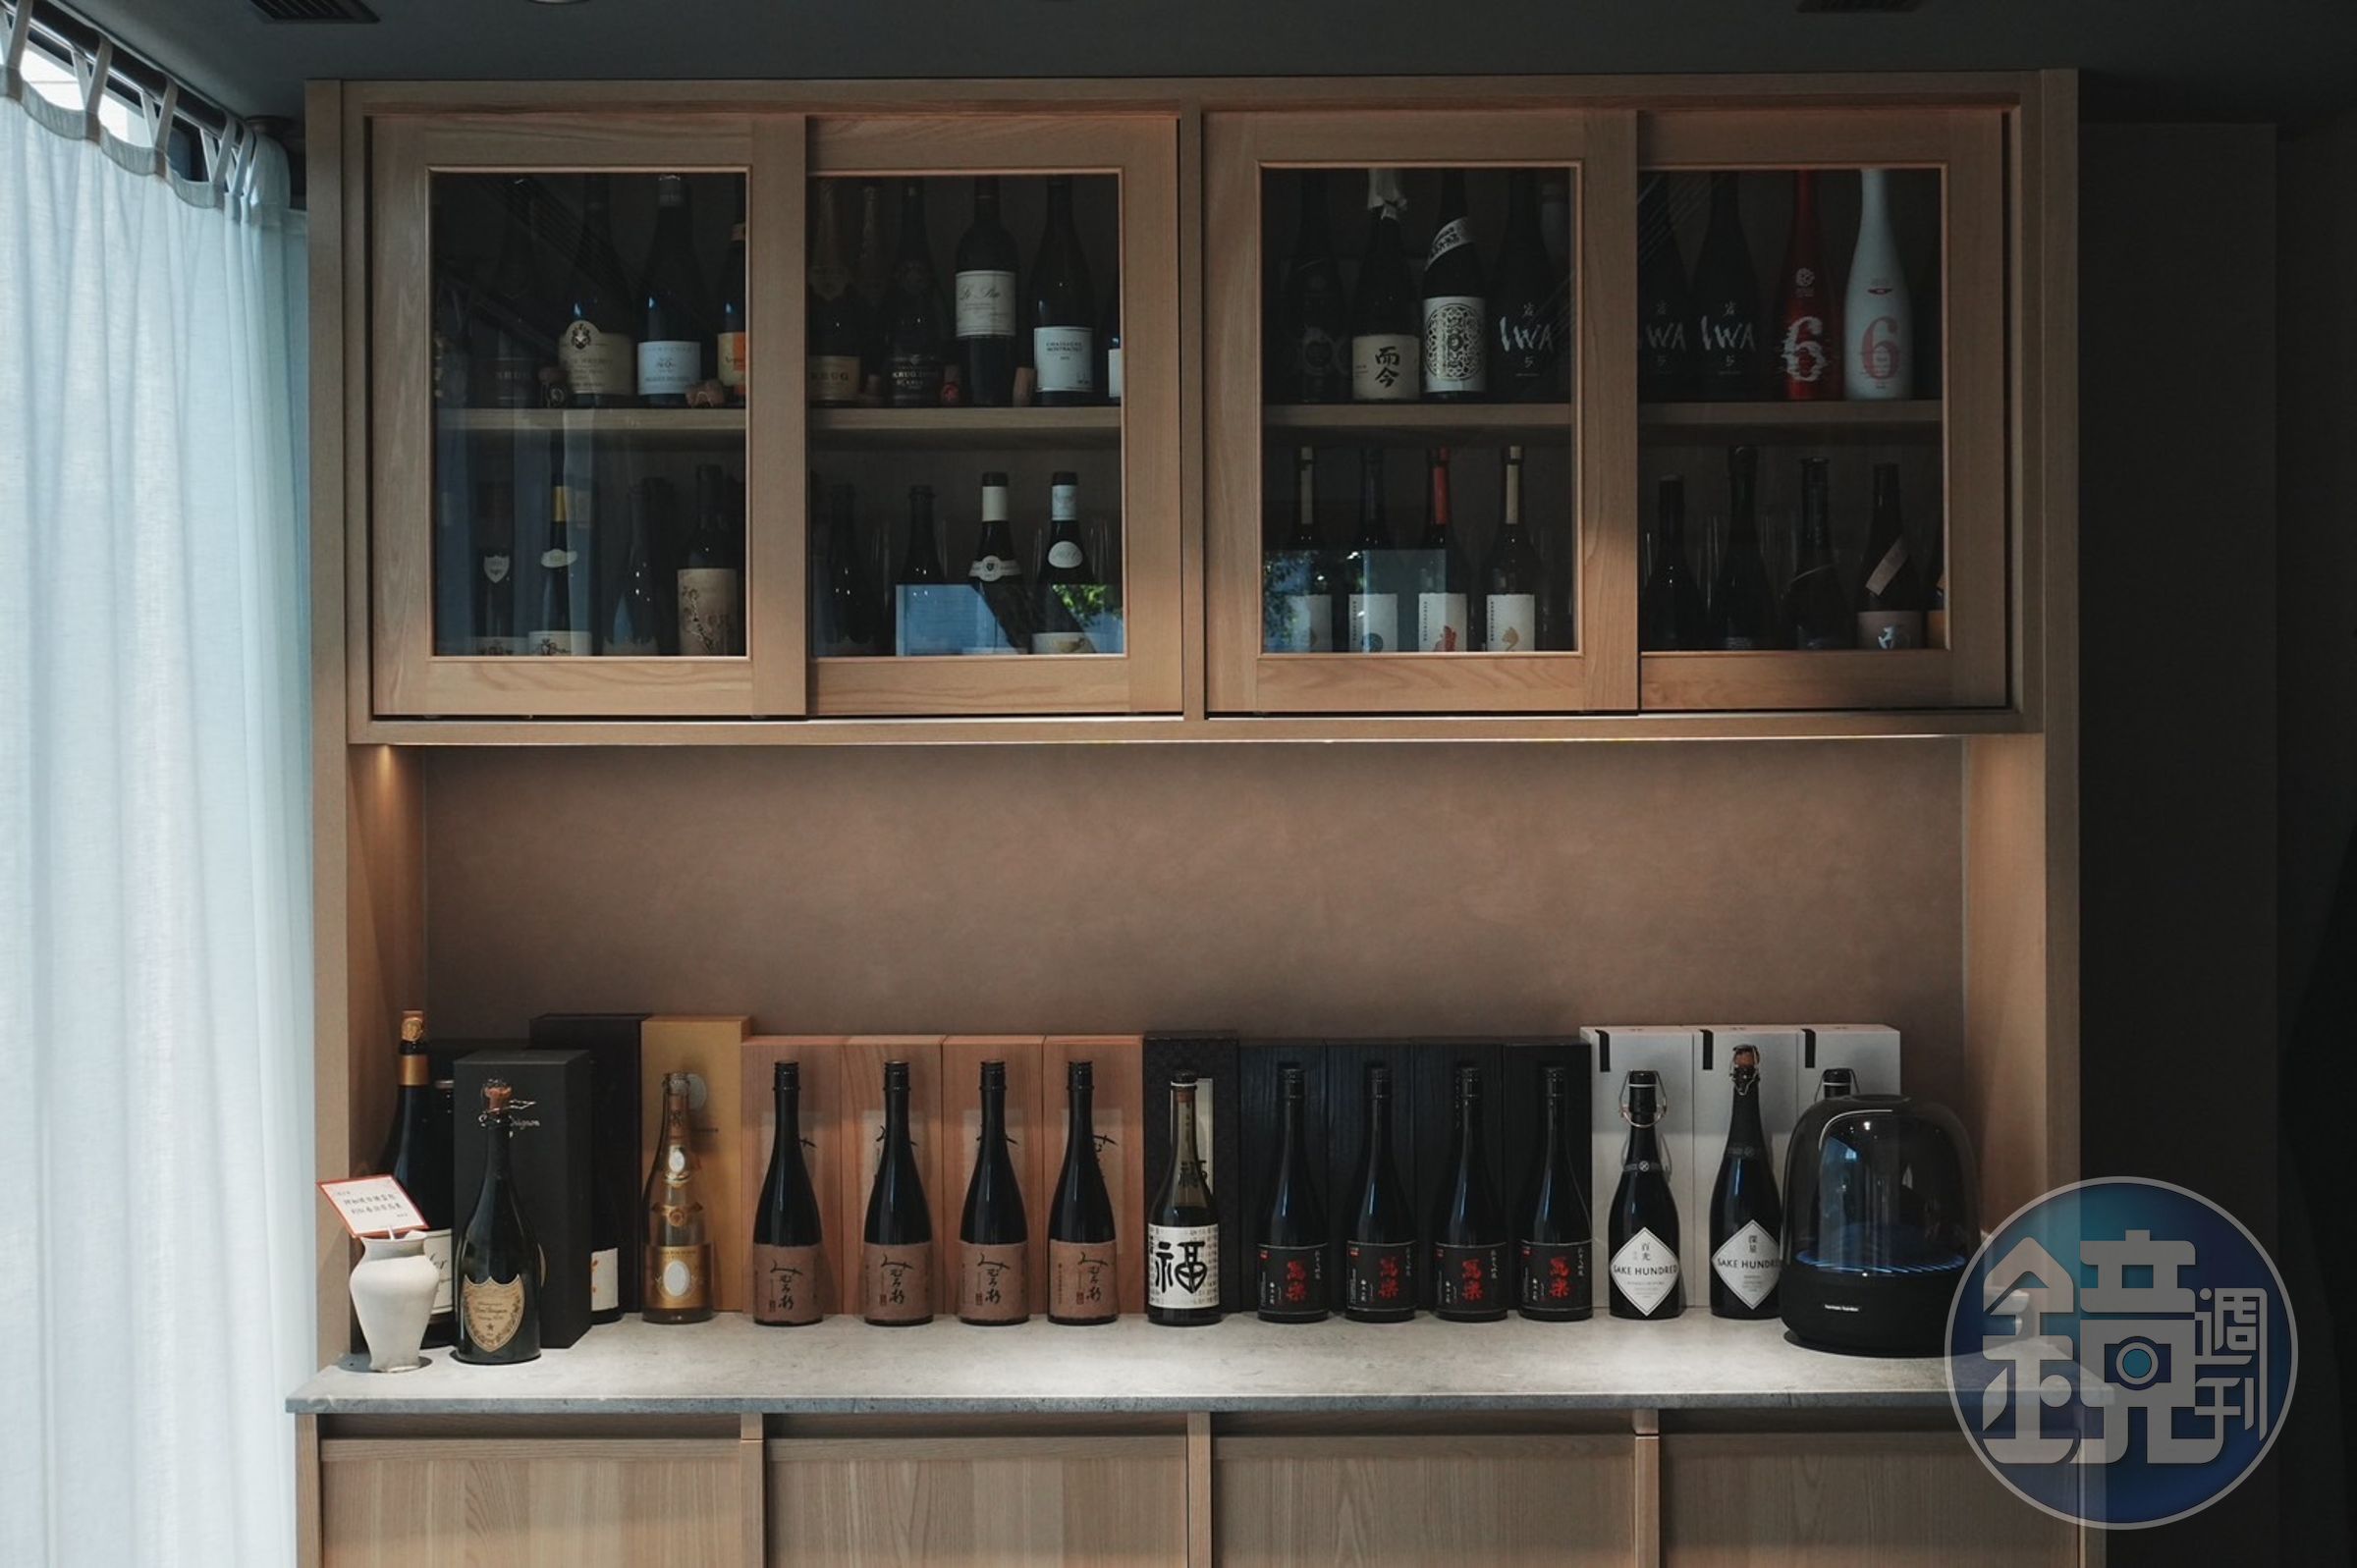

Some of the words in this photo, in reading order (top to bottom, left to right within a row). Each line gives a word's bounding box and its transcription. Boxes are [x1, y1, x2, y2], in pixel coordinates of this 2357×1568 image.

[1499, 315, 1555, 354] IWA
[1642, 321, 1687, 353] WA
[1700, 314, 1757, 353] IWA
[1782, 315, 1829, 382] 6
[1861, 315, 1900, 380] 6
[1375, 346, 1400, 388] 而今
[1155, 1241, 1208, 1294] 福
[1613, 1265, 1632, 1275] SAKE
[1634, 1266, 1677, 1276] HUNDRED
[1717, 1258, 1738, 1269] SAKE
[1741, 1259, 1781, 1270] HUNDRE
